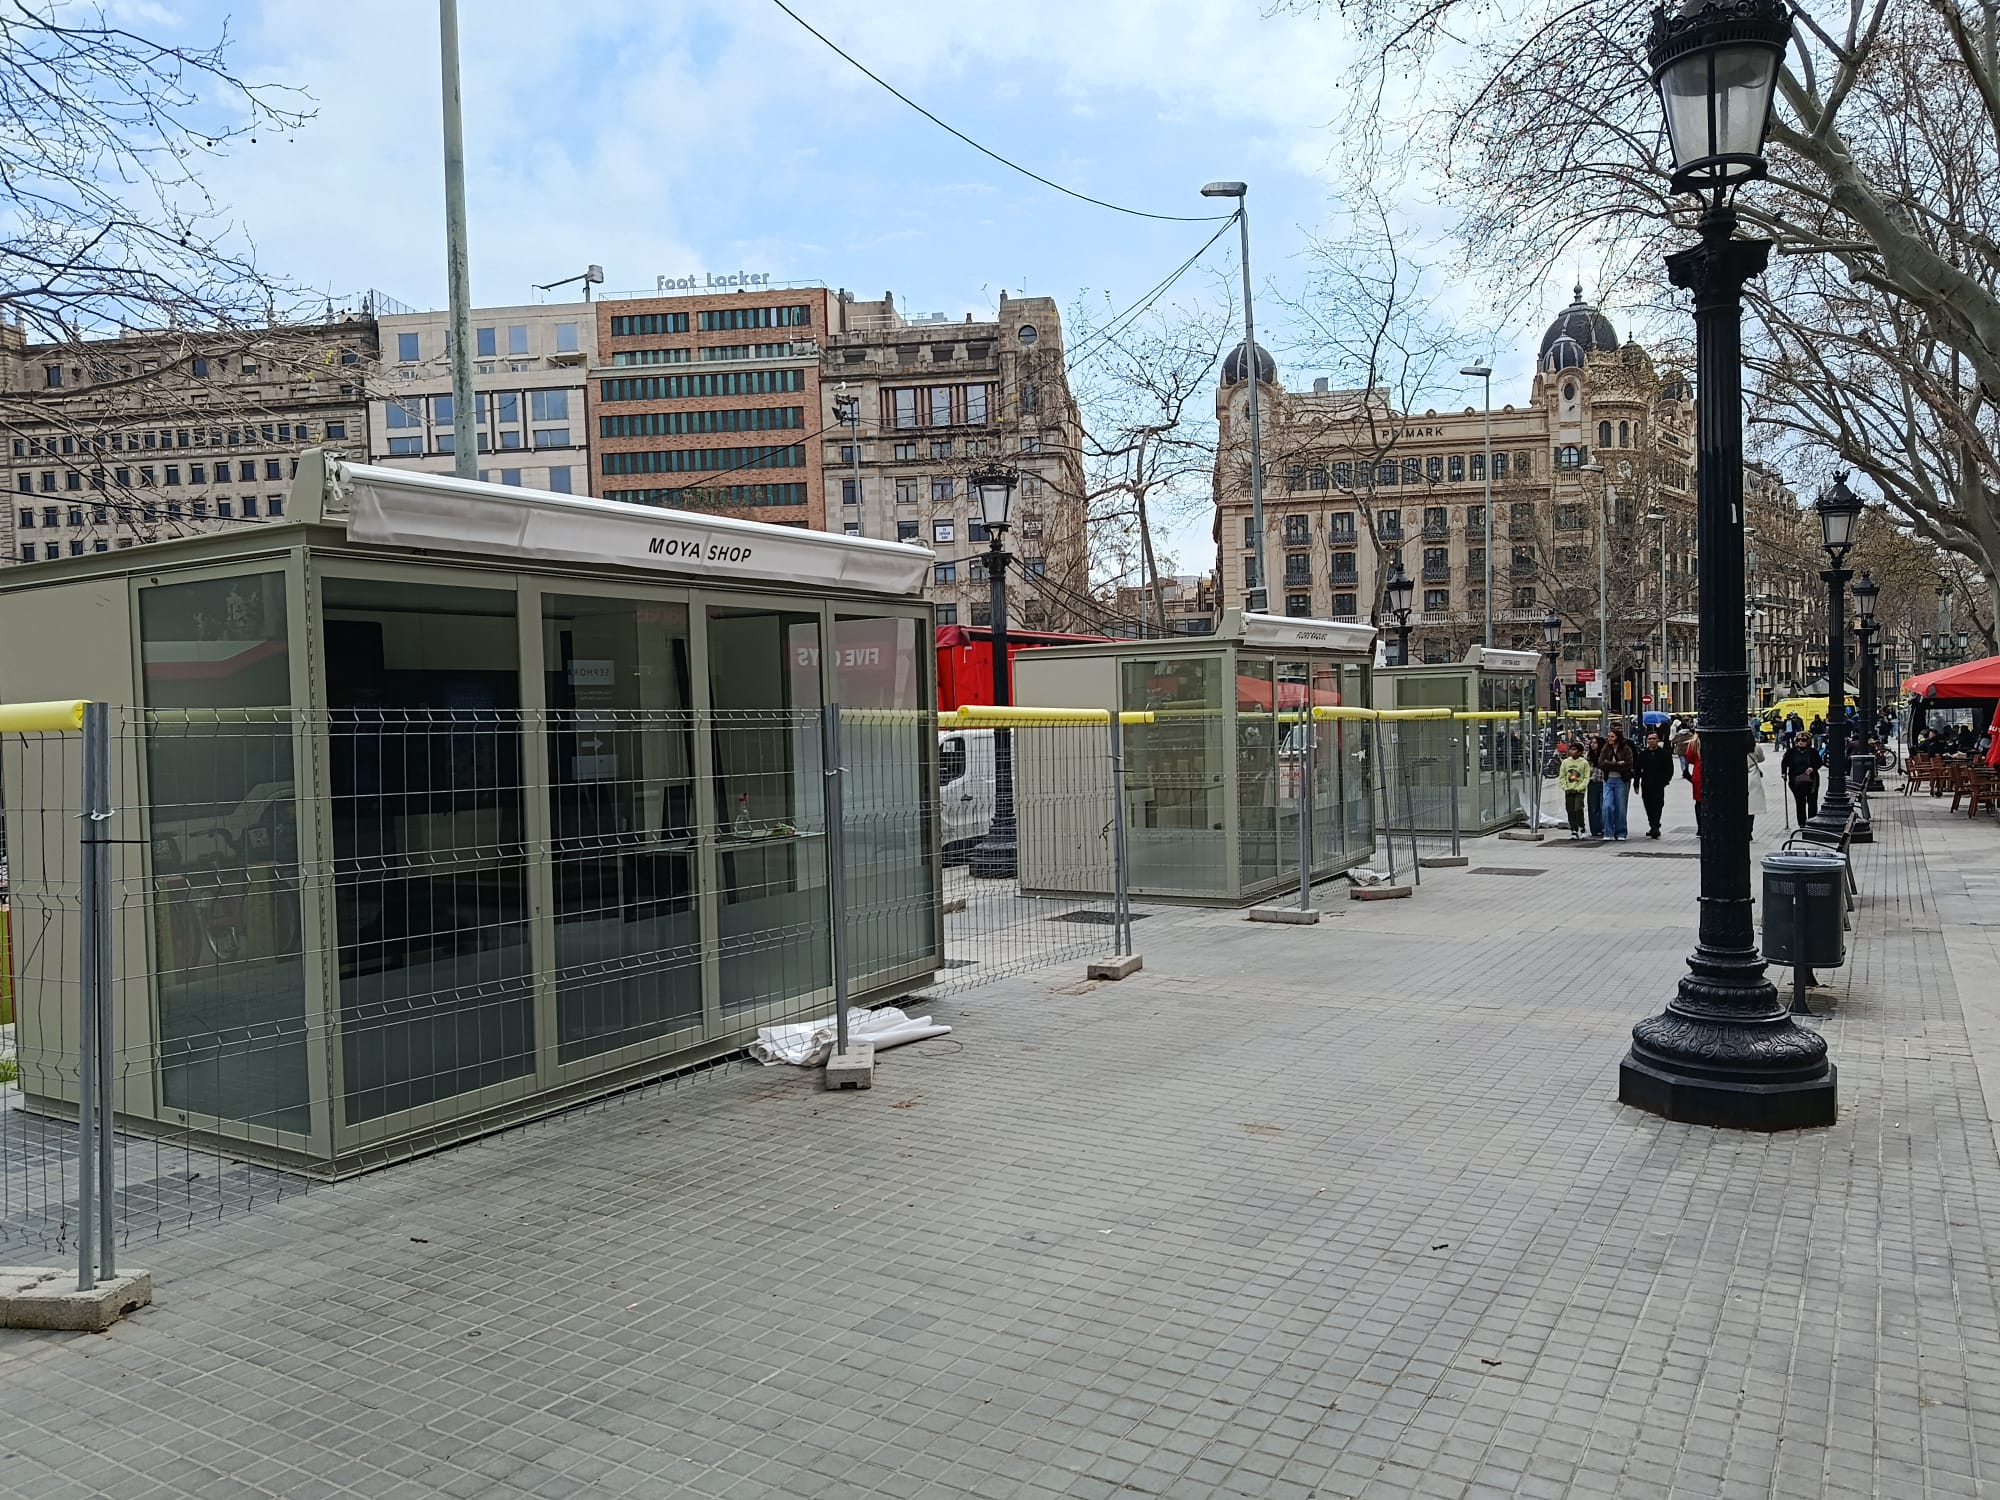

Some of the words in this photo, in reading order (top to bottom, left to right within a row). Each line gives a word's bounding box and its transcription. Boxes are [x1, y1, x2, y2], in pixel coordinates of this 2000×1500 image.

[656, 275, 696, 290] Foot
[706, 270, 770, 287] Locker
[649, 538, 700, 558] MOYA
[708, 545, 752, 562] SHOP
